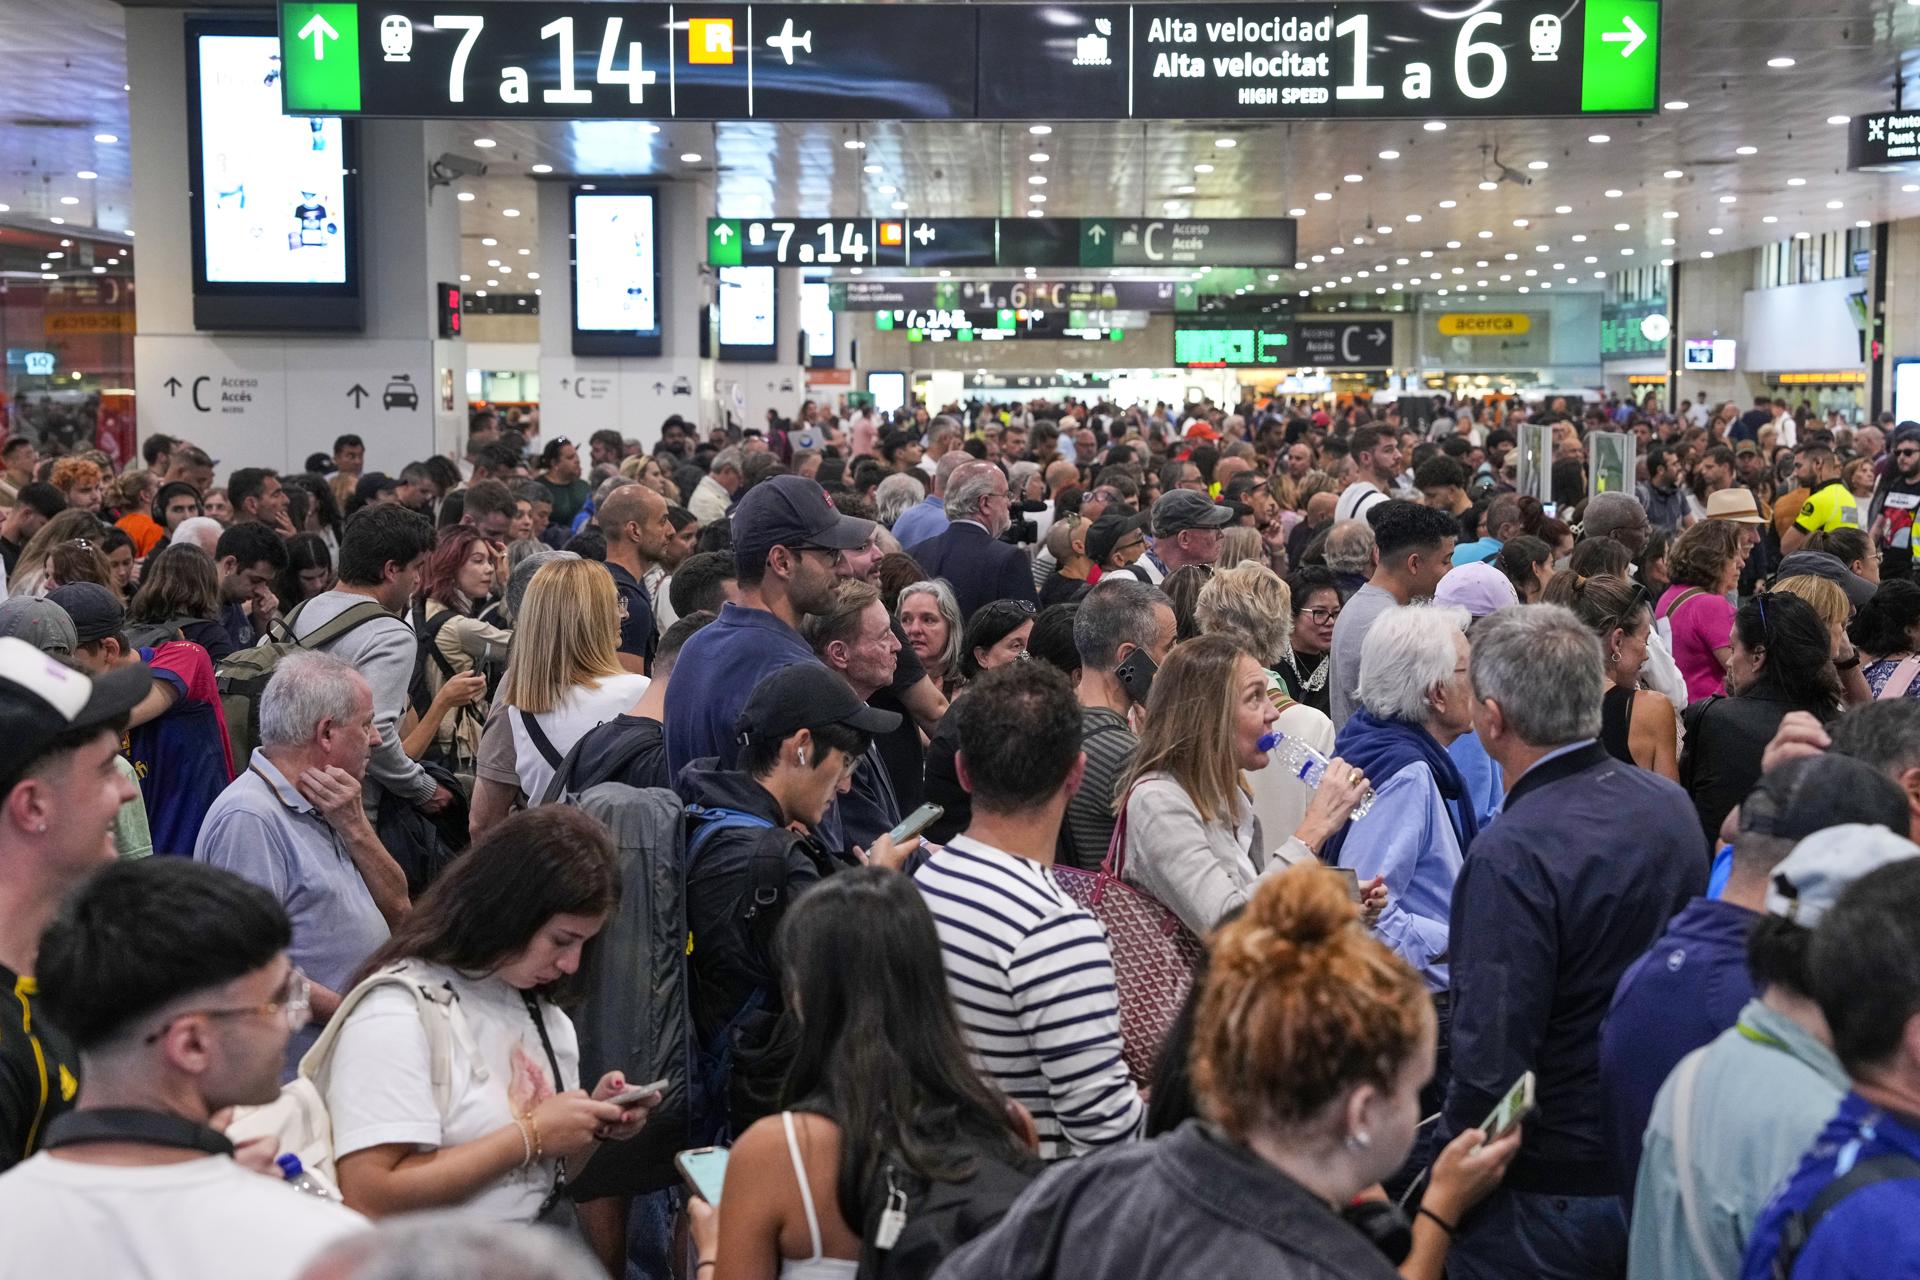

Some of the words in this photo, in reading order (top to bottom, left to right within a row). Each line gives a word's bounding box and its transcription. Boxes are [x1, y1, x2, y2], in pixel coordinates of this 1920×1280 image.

[705, 23, 733, 53] R
[1147, 17, 1198, 43] Alta
[1206, 16, 1330, 43] velocidad
[433, 15, 484, 103] 7
[499, 66, 529, 104] a
[540, 16, 656, 104] 14
[1152, 53, 1206, 78] Alta
[1213, 52, 1330, 78] velocitat
[1335, 14, 1385, 100] 1
[1402, 61, 1431, 99] a
[1454, 11, 1508, 100] 6
[1238, 89, 1278, 104] HIGH
[1281, 88, 1329, 104] SPEED
[771, 222, 796, 263] 7
[816, 222, 869, 263] 14
[1144, 222, 1164, 261] C
[1455, 317, 1514, 330] acerca
[1341, 325, 1361, 362] C
[192, 376, 211, 412] C
[221, 376, 258, 387] Acceso
[221, 391, 252, 402] Accés
